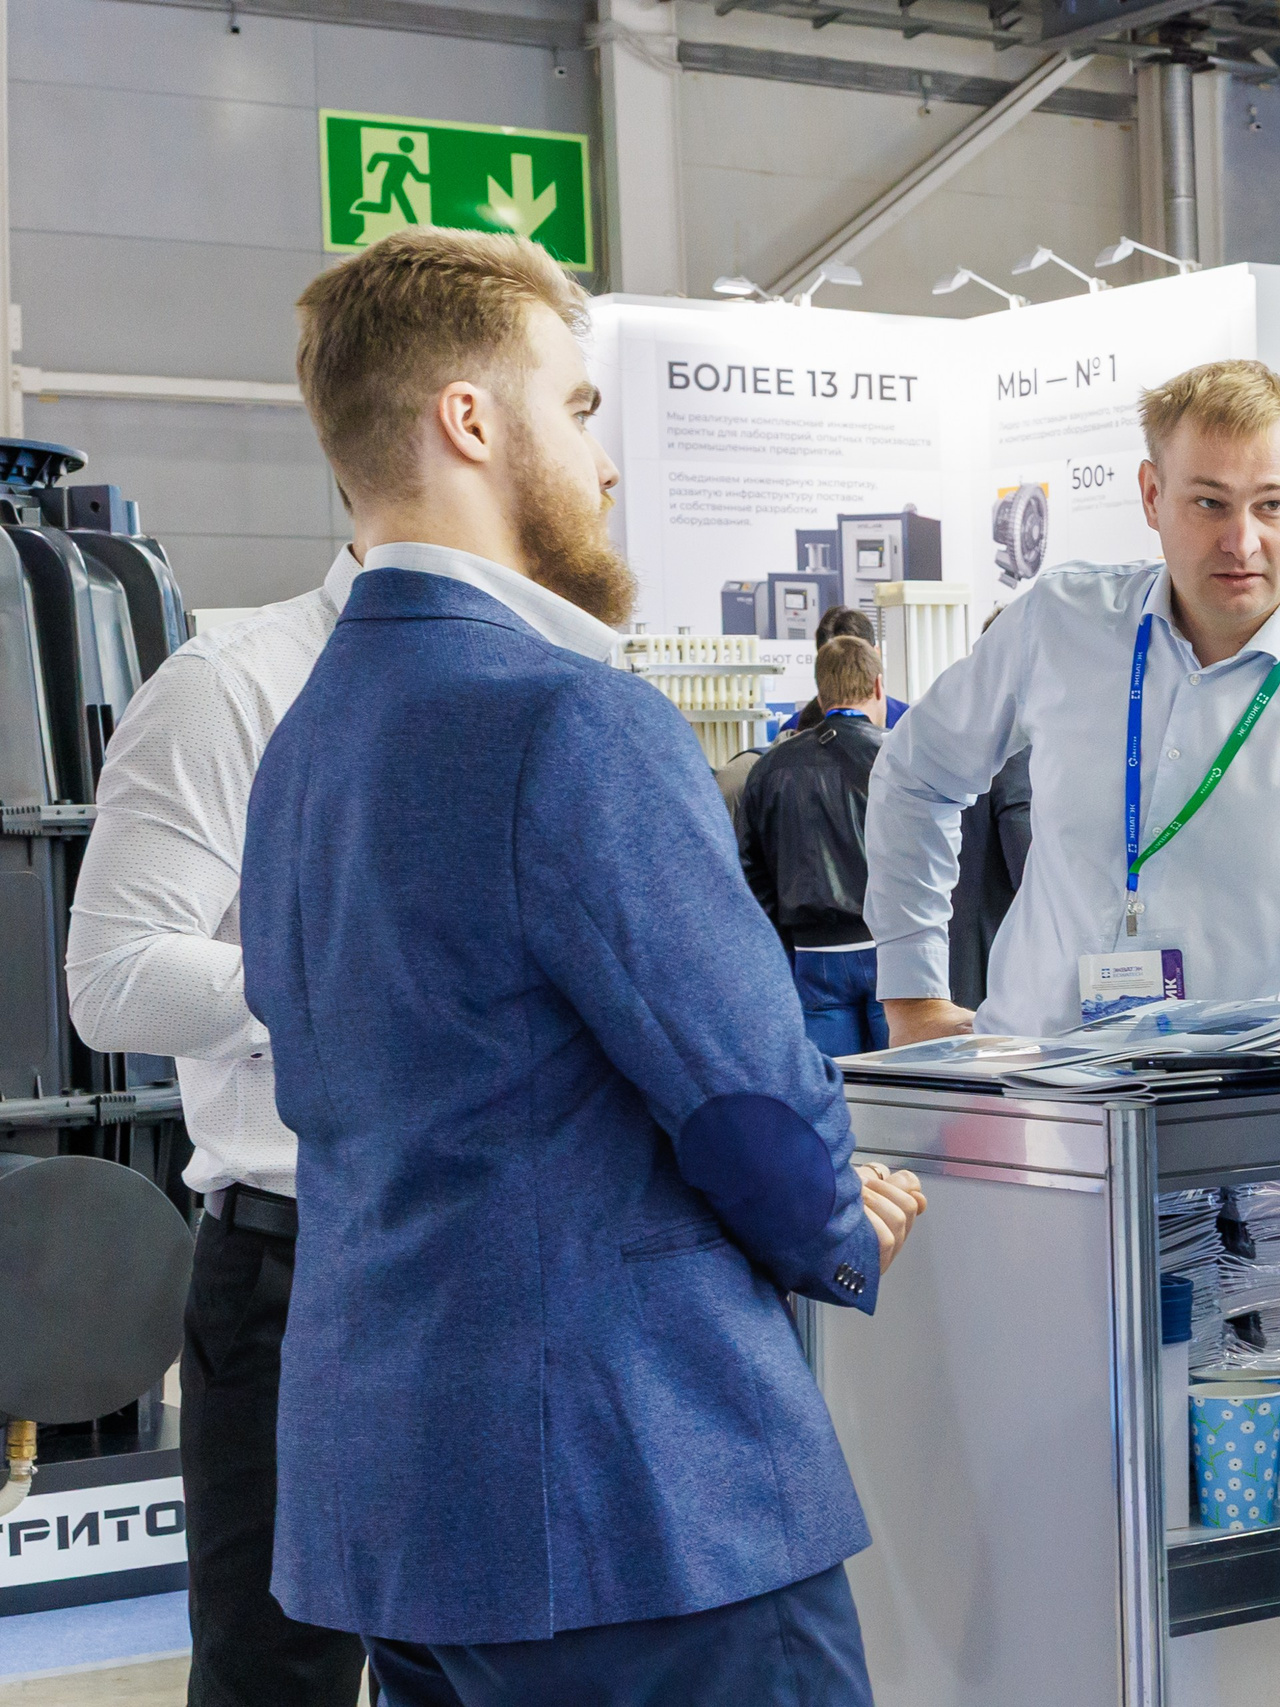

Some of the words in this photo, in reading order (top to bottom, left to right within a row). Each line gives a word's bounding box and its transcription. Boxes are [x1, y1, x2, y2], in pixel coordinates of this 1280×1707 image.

[667, 361, 795, 397] БОЛЕЕ
[806, 370, 838, 398] 13
[850, 373, 918, 402] ЛЕТ
[998, 368, 1037, 401] МЫ
[1071, 464, 1115, 490] 500+
[0, 1500, 186, 1557] РИТО
